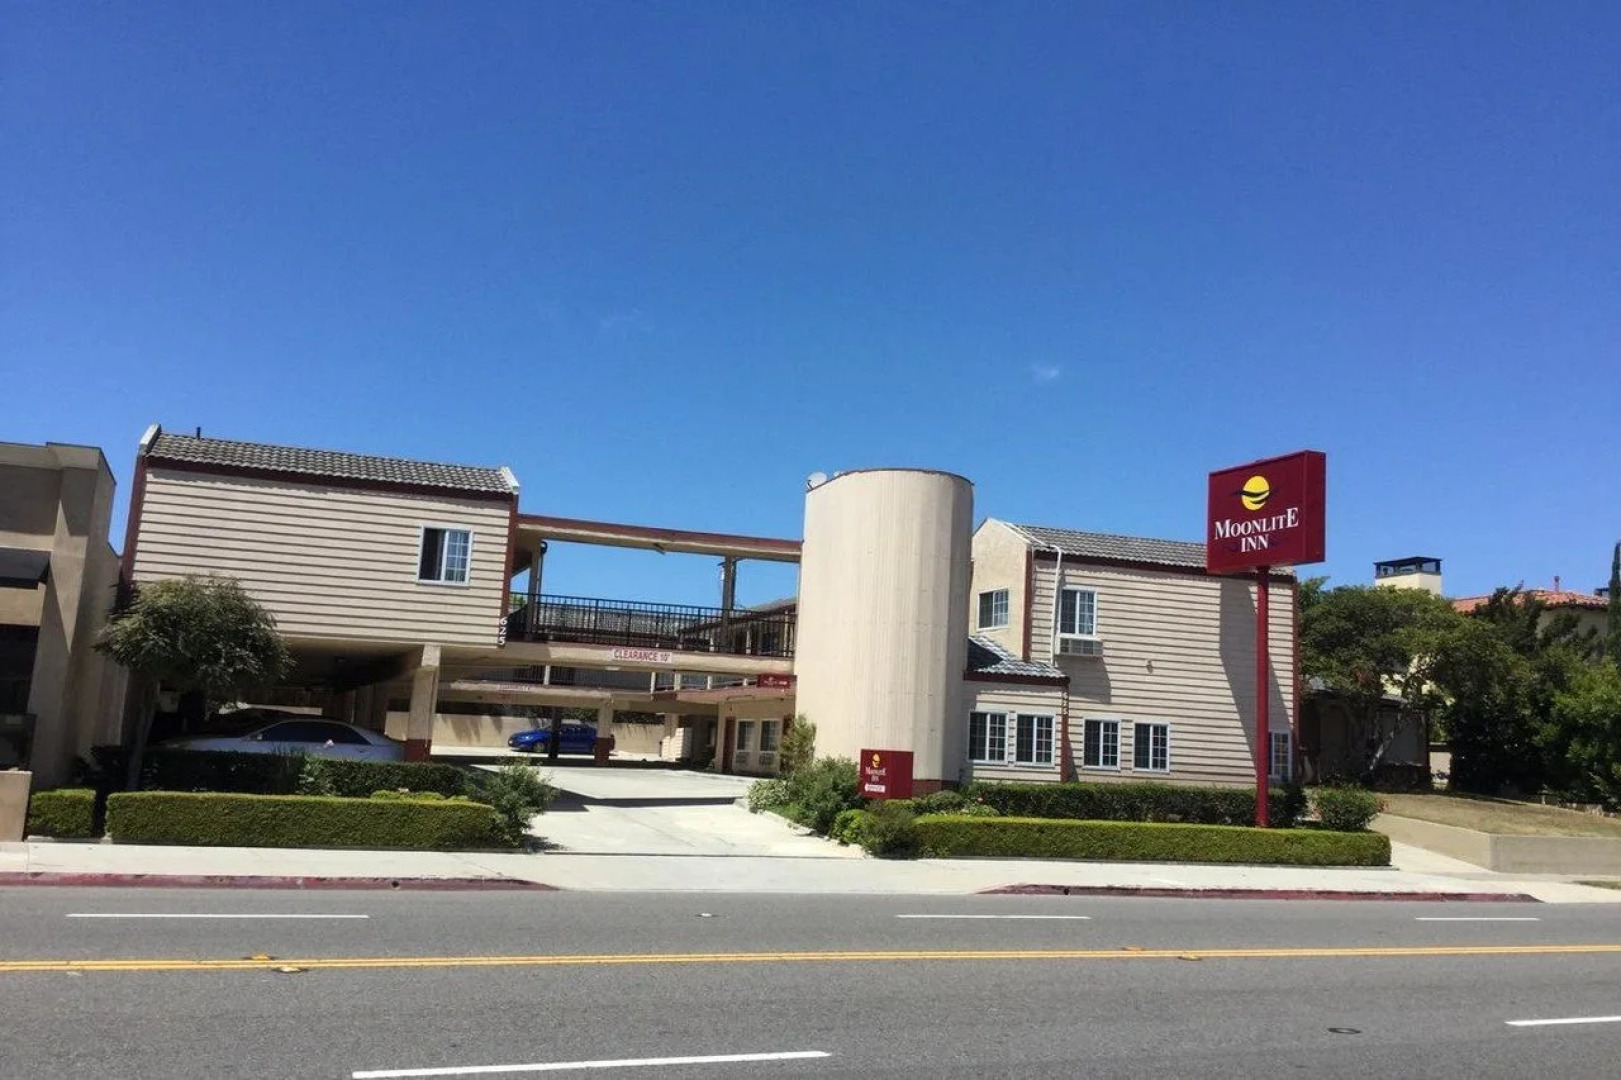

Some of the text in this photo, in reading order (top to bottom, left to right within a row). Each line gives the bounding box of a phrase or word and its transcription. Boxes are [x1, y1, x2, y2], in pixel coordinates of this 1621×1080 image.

[1240, 534, 1269, 553] INN
[499, 616, 508, 646] 625
[613, 649, 658, 662] CLEARANCE
